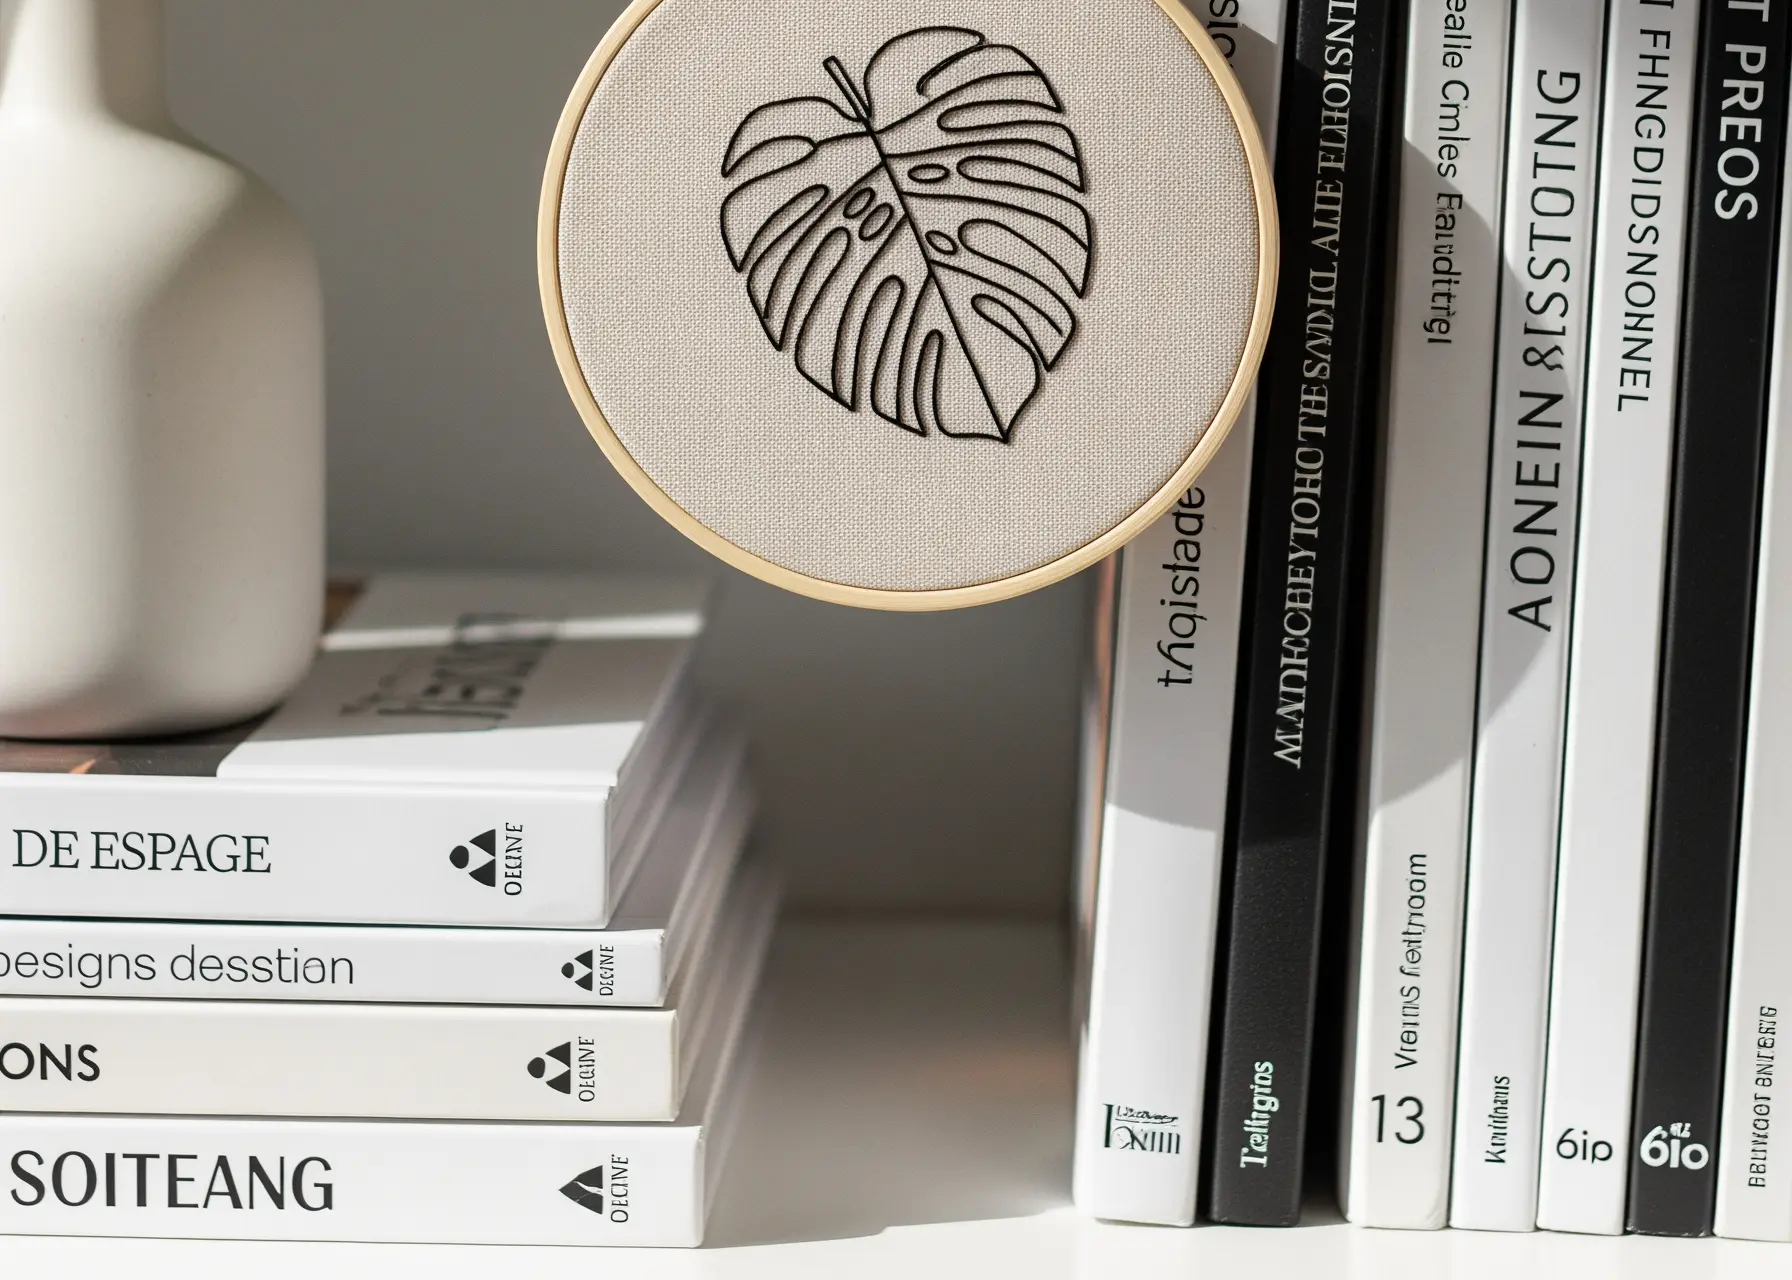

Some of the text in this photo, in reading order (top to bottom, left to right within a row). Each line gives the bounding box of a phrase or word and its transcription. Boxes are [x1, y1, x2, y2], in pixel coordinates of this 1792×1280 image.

[1714, 43, 1767, 220] PREOS
[1507, 390, 1564, 632] AONEIN
[12, 829, 272, 873] DE ESPAGE
[0, 1042, 101, 1082] ONS
[1371, 1094, 1425, 1145] 13
[9, 1149, 334, 1211] SOITEANG
